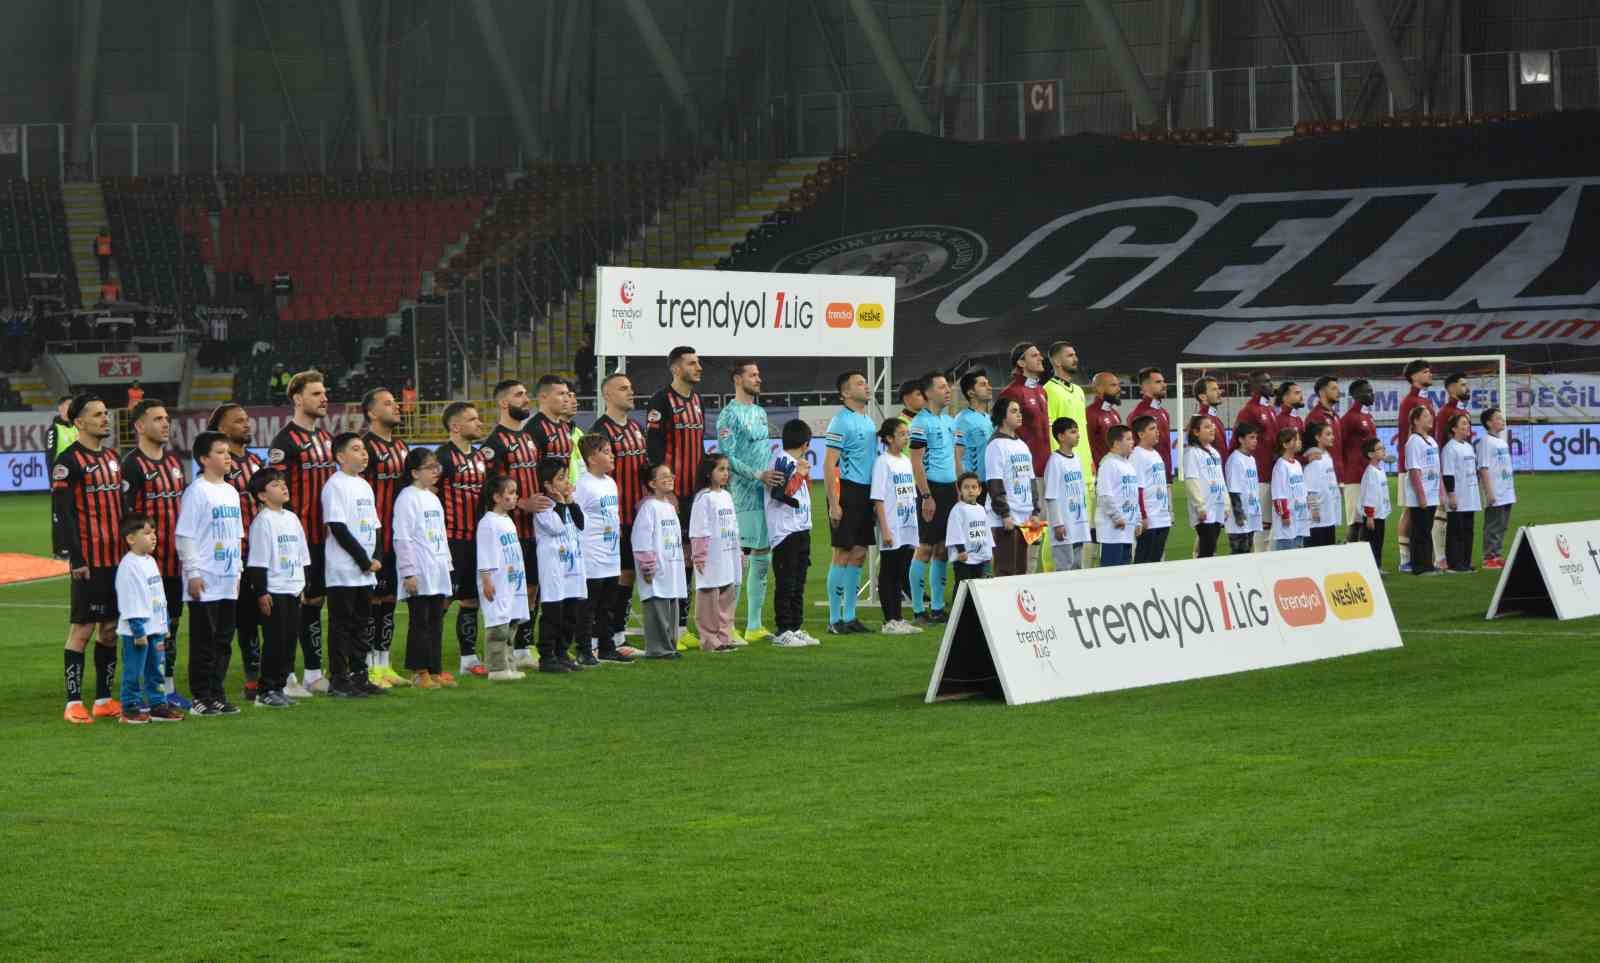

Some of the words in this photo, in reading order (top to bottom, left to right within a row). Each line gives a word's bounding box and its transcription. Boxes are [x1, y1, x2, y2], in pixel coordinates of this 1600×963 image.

[1031, 84, 1053, 110] C1
[656, 289, 766, 337] trendyol
[1550, 428, 1600, 466] gdh
[12, 456, 43, 487] gdh
[1067, 582, 1215, 650] trendyol
[1279, 591, 1322, 611] trendyol
[1016, 625, 1057, 645] trendyol
